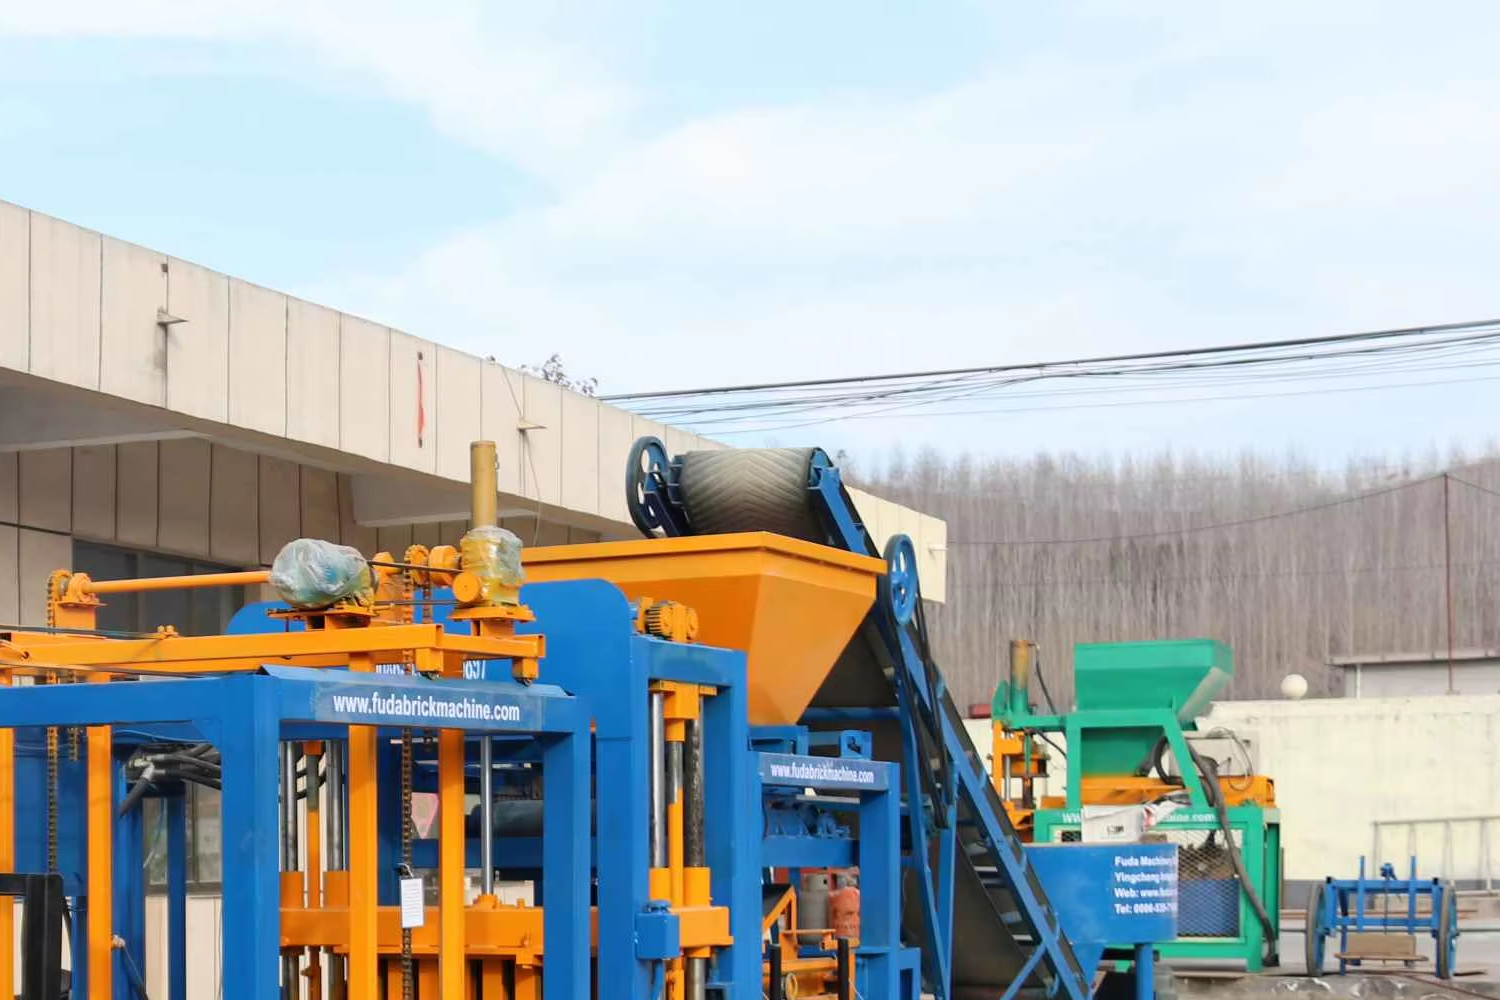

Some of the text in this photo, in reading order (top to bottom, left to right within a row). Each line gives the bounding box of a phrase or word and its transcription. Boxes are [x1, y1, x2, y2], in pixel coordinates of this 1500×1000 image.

[333, 691, 520, 721] www.fudabrickmachine.com
[770, 762, 875, 783] www.fudabrickmachine.com
[1114, 855, 1139, 867] Fuda
